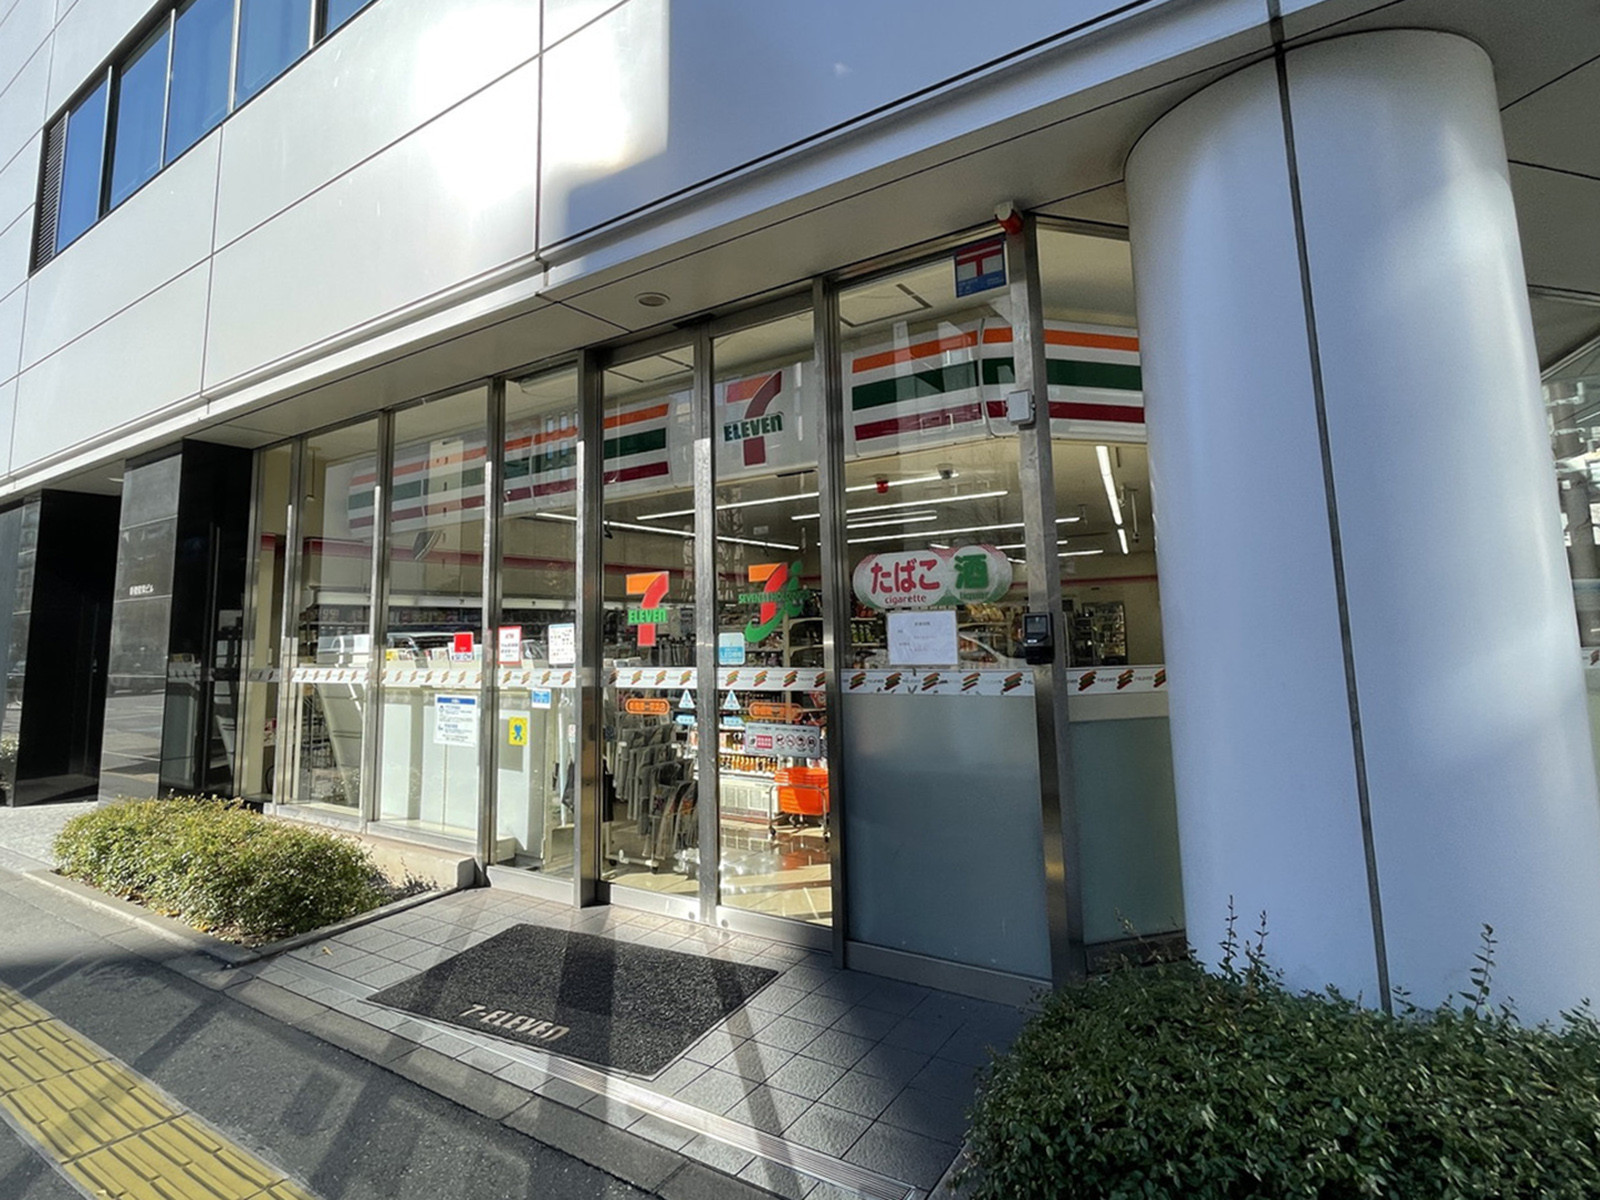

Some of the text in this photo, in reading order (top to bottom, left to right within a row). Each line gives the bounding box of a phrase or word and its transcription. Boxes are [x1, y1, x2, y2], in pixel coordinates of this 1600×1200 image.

[870, 557, 941, 595] たばこ
[954, 553, 990, 590] 酒
[884, 594, 927, 605] cigarette
